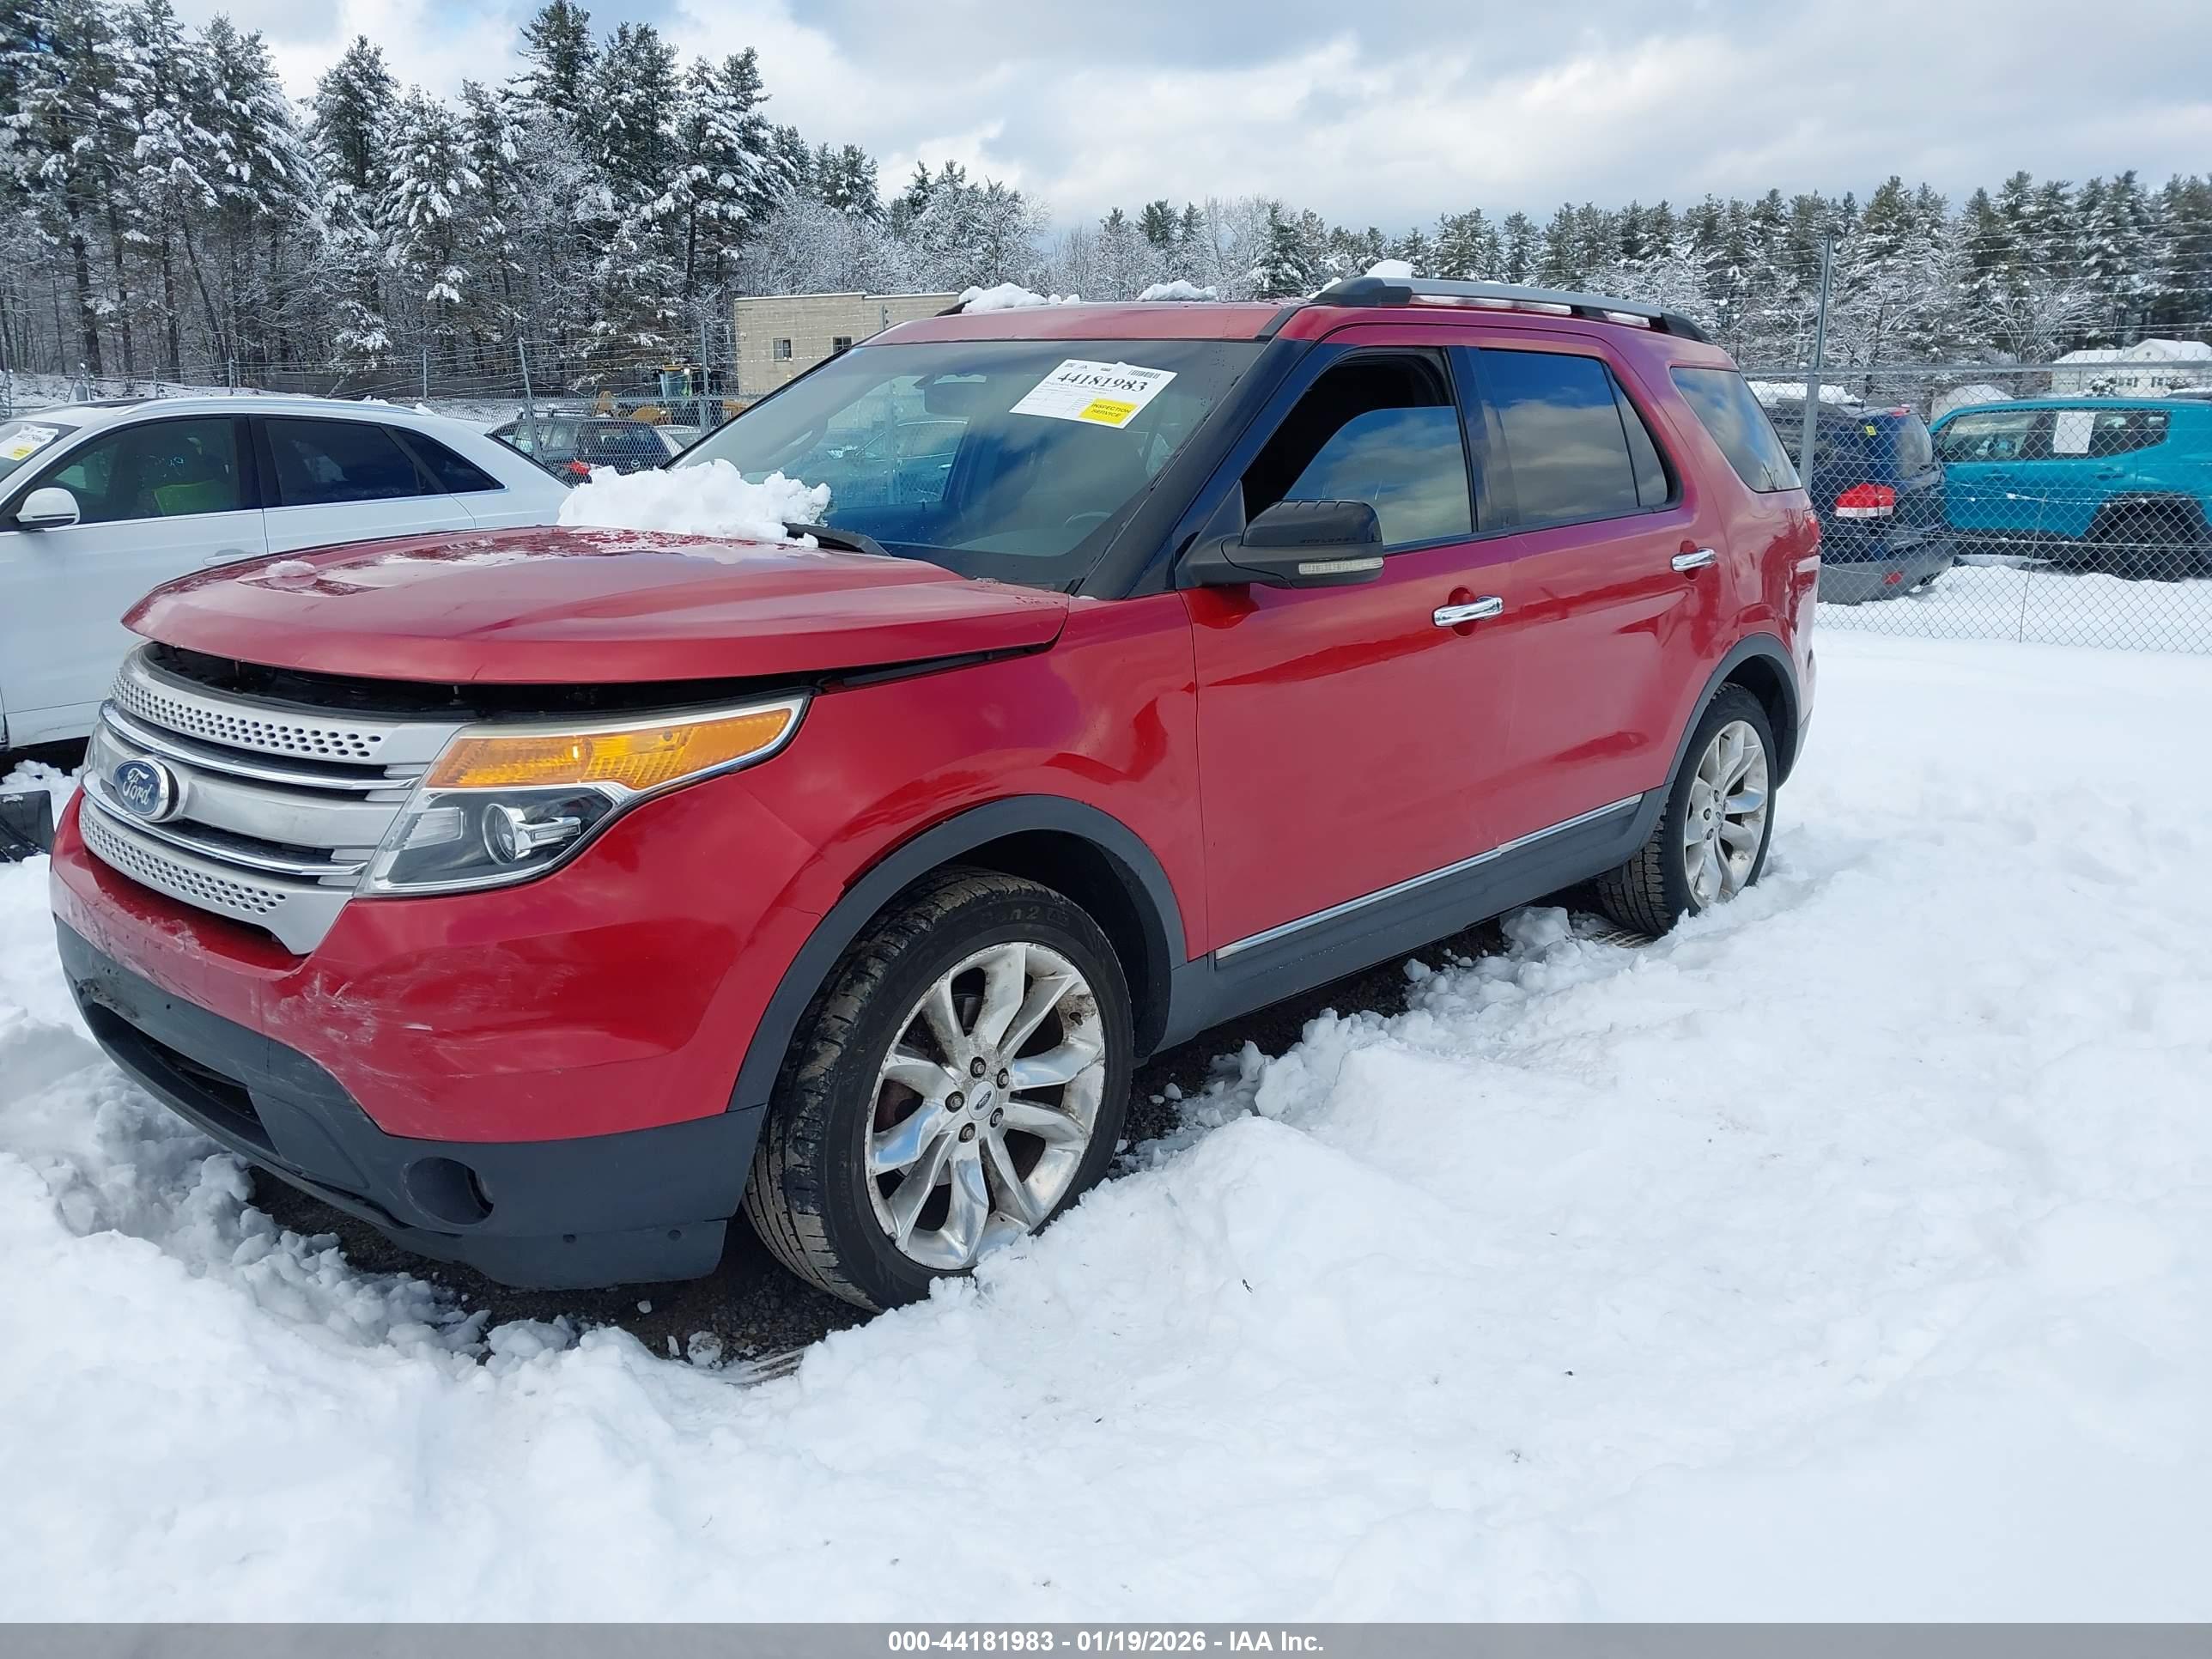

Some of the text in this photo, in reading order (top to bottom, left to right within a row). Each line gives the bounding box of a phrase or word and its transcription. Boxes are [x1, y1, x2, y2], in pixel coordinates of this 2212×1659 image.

[1057, 372, 1148, 392] 44181983
[1091, 403, 1133, 414] INSPECTION
[1091, 410, 1122, 418] SERVICE
[122, 767, 154, 805] Ford
